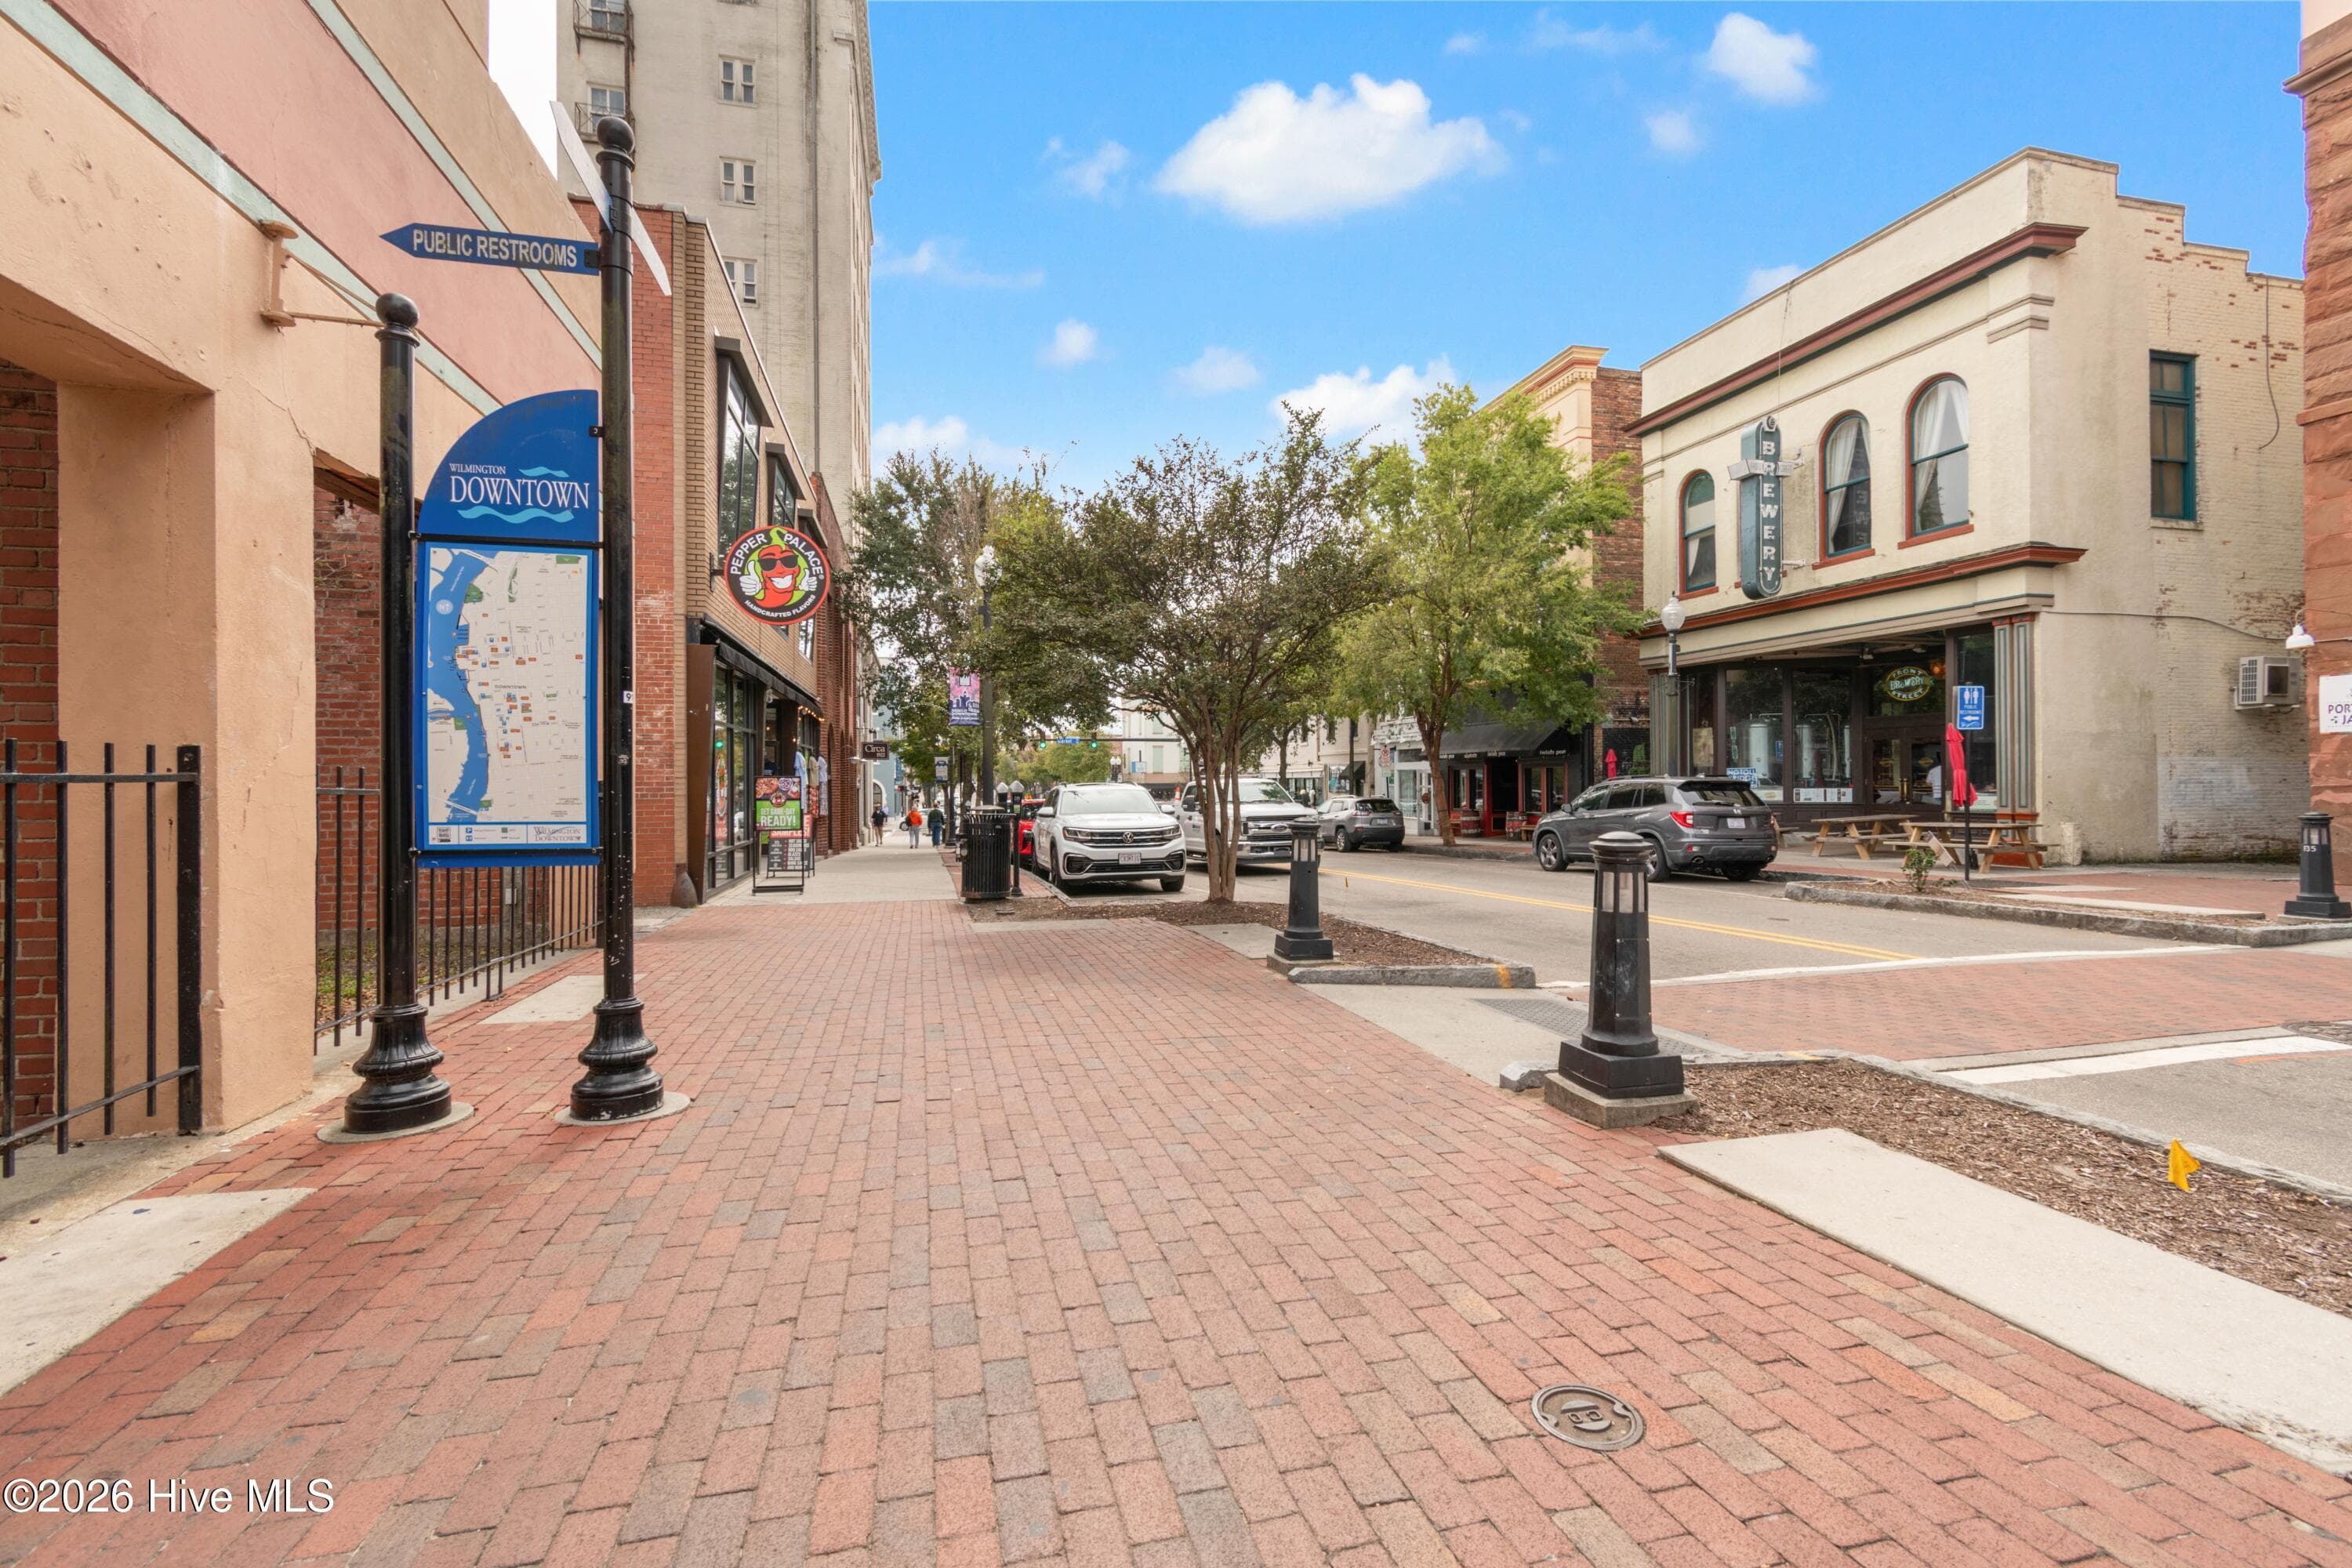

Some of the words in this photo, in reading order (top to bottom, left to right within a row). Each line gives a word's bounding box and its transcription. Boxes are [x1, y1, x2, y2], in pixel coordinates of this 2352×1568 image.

[413, 229, 472, 256] PUBLIC
[477, 236, 577, 267] RESTROOMS
[449, 463, 506, 474] WILMINGTON
[450, 475, 590, 509] DOWNTOWN
[1760, 441, 1778, 581] BREWERY
[731, 533, 768, 575] PEPPER
[784, 533, 824, 575] PALACE
[745, 600, 792, 617] HANDCRAFTED
[792, 594, 816, 615] FLAVORS
[2328, 703, 2352, 714] POR
[760, 815, 796, 827] READY!
